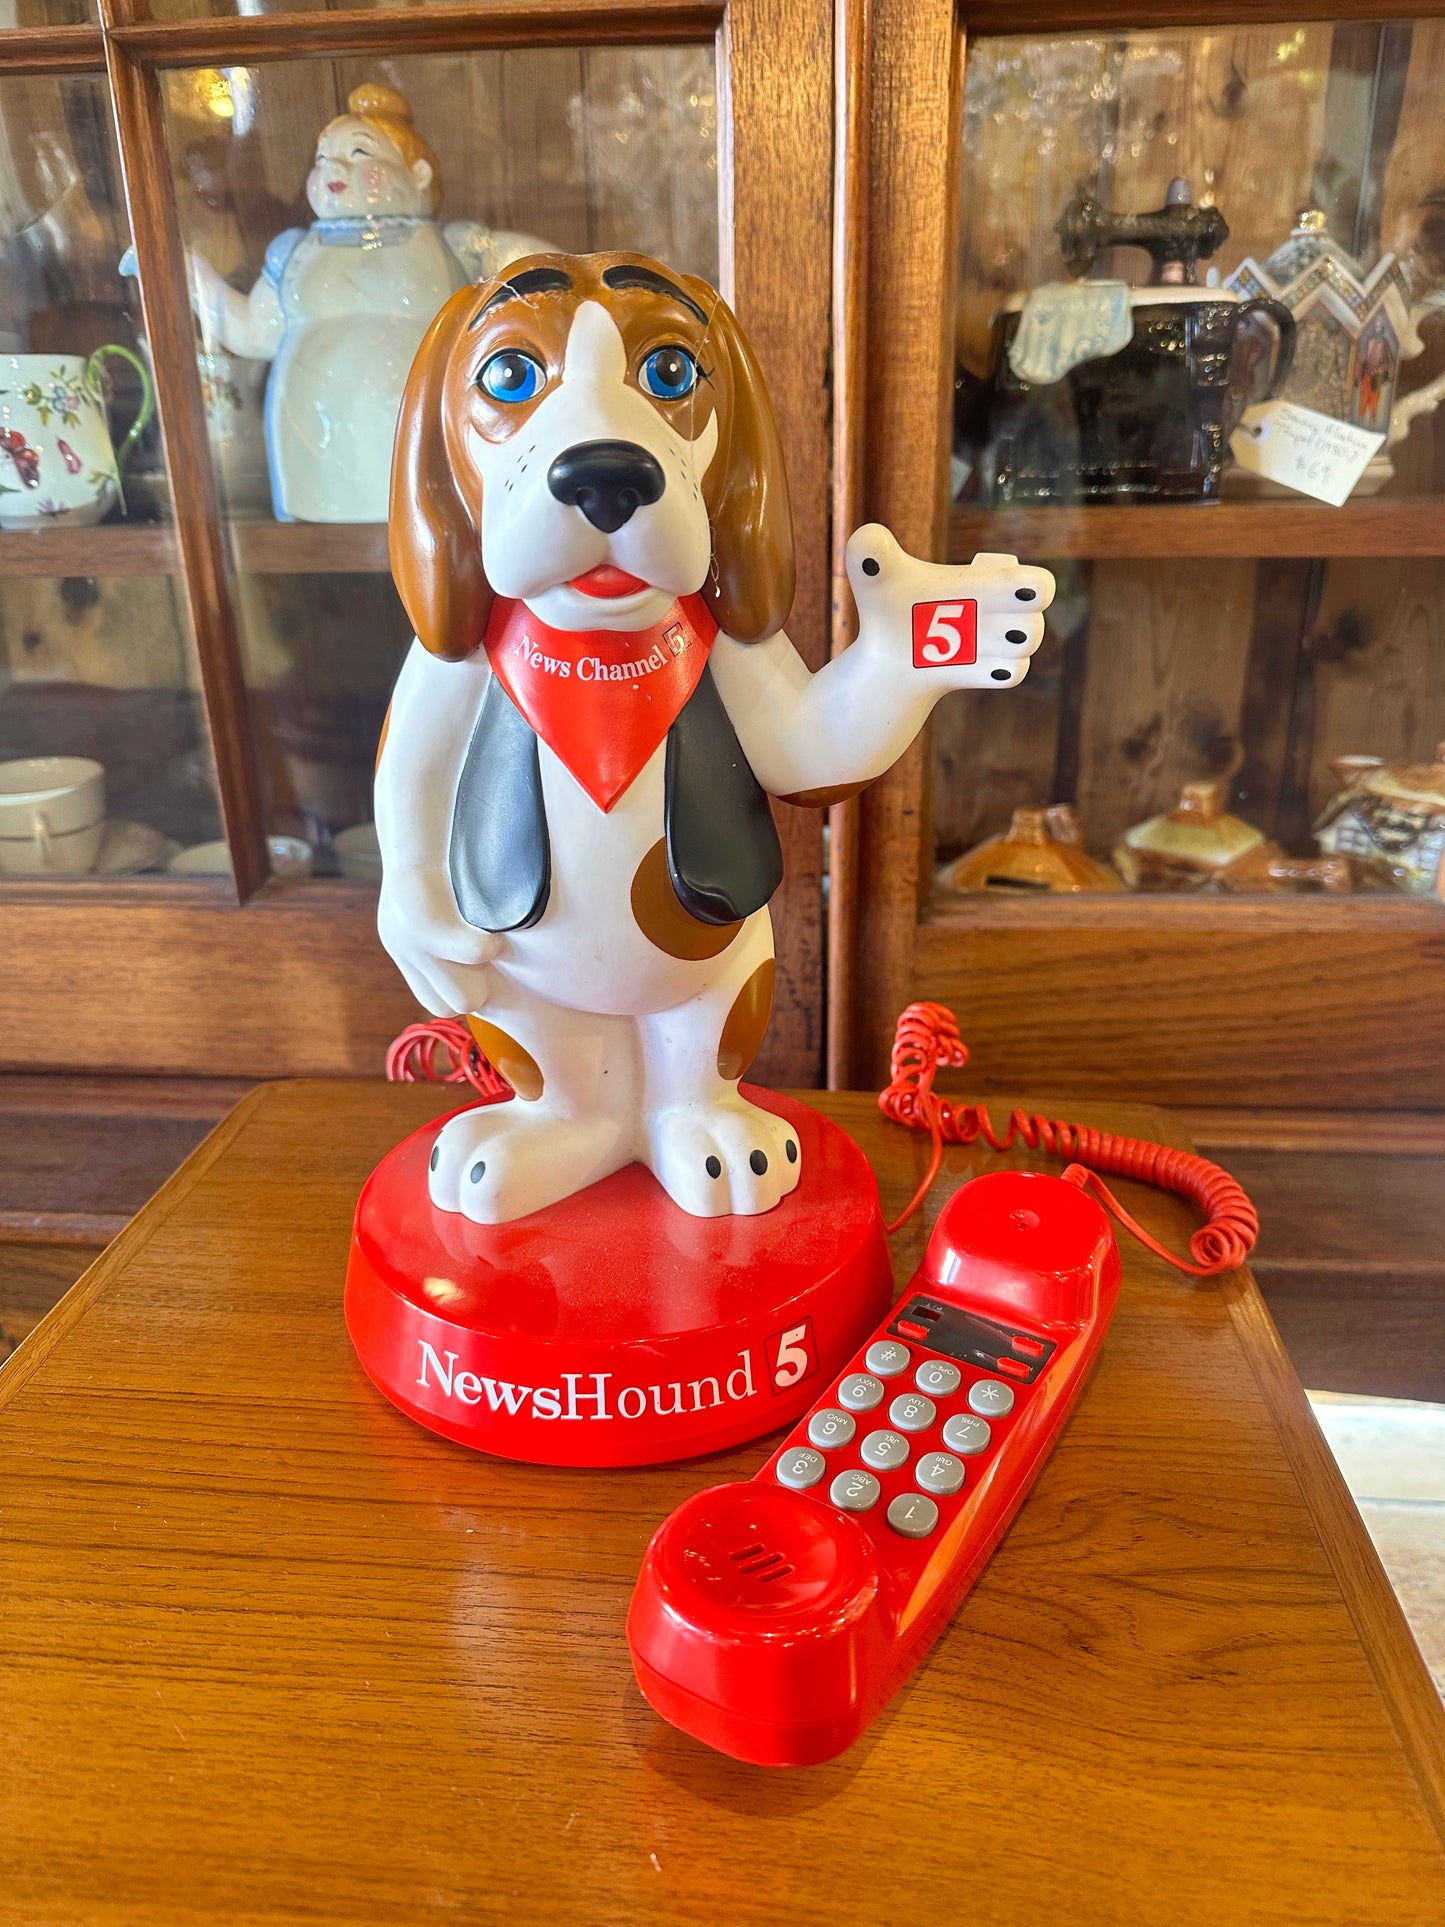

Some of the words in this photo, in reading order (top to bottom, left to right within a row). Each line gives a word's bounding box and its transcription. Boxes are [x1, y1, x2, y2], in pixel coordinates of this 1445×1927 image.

[1295, 455, 1331, 487] $69
[922, 604, 965, 663] 5
[513, 633, 571, 678] News
[576, 643, 670, 682] Channel
[667, 626, 686, 656] 5
[415, 1338, 758, 1421] NewsHound
[774, 1323, 809, 1388] 5
[928, 1371, 943, 1384] 0
[856, 1377, 876, 1389] WXY
[851, 1384, 867, 1398] 9
[908, 1397, 926, 1409] TUV
[903, 1404, 918, 1418] 8
[826, 1413, 848, 1425] MNO
[960, 1416, 981, 1428] PRS
[822, 1421, 838, 1435] 6
[955, 1425, 971, 1439] 7
[884, 1434, 900, 1445] JKL
[874, 1441, 891, 1457] 5
[798, 1452, 818, 1463] DEF
[935, 1455, 953, 1466] GHI
[792, 1460, 808, 1474] 3
[930, 1463, 945, 1477] 4
[852, 1473, 872, 1485] ABC
[846, 1481, 864, 1497] 2
[904, 1505, 916, 1519] 1
